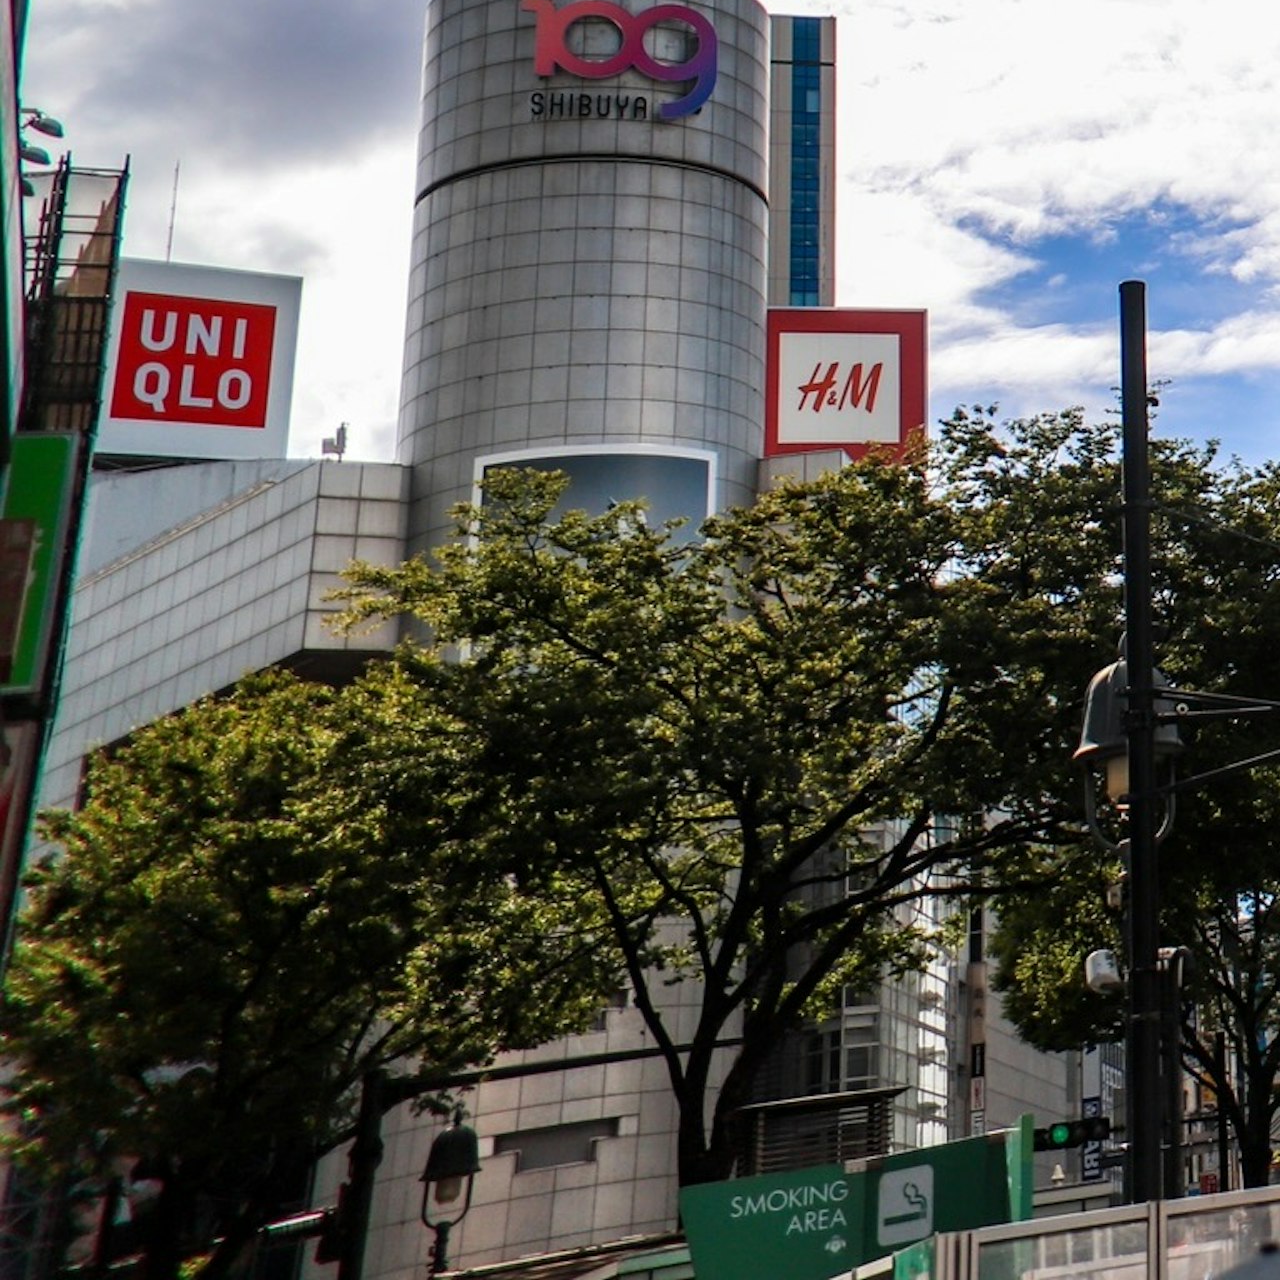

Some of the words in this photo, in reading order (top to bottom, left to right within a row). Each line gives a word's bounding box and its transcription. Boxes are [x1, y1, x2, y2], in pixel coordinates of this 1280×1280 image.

[530, 91, 649, 122] SHIBUYA
[139, 307, 249, 362] UNI
[132, 361, 254, 413] QLO
[796, 360, 884, 416] H&M
[729, 1179, 850, 1219] SMOKING
[786, 1207, 848, 1237] AREA
